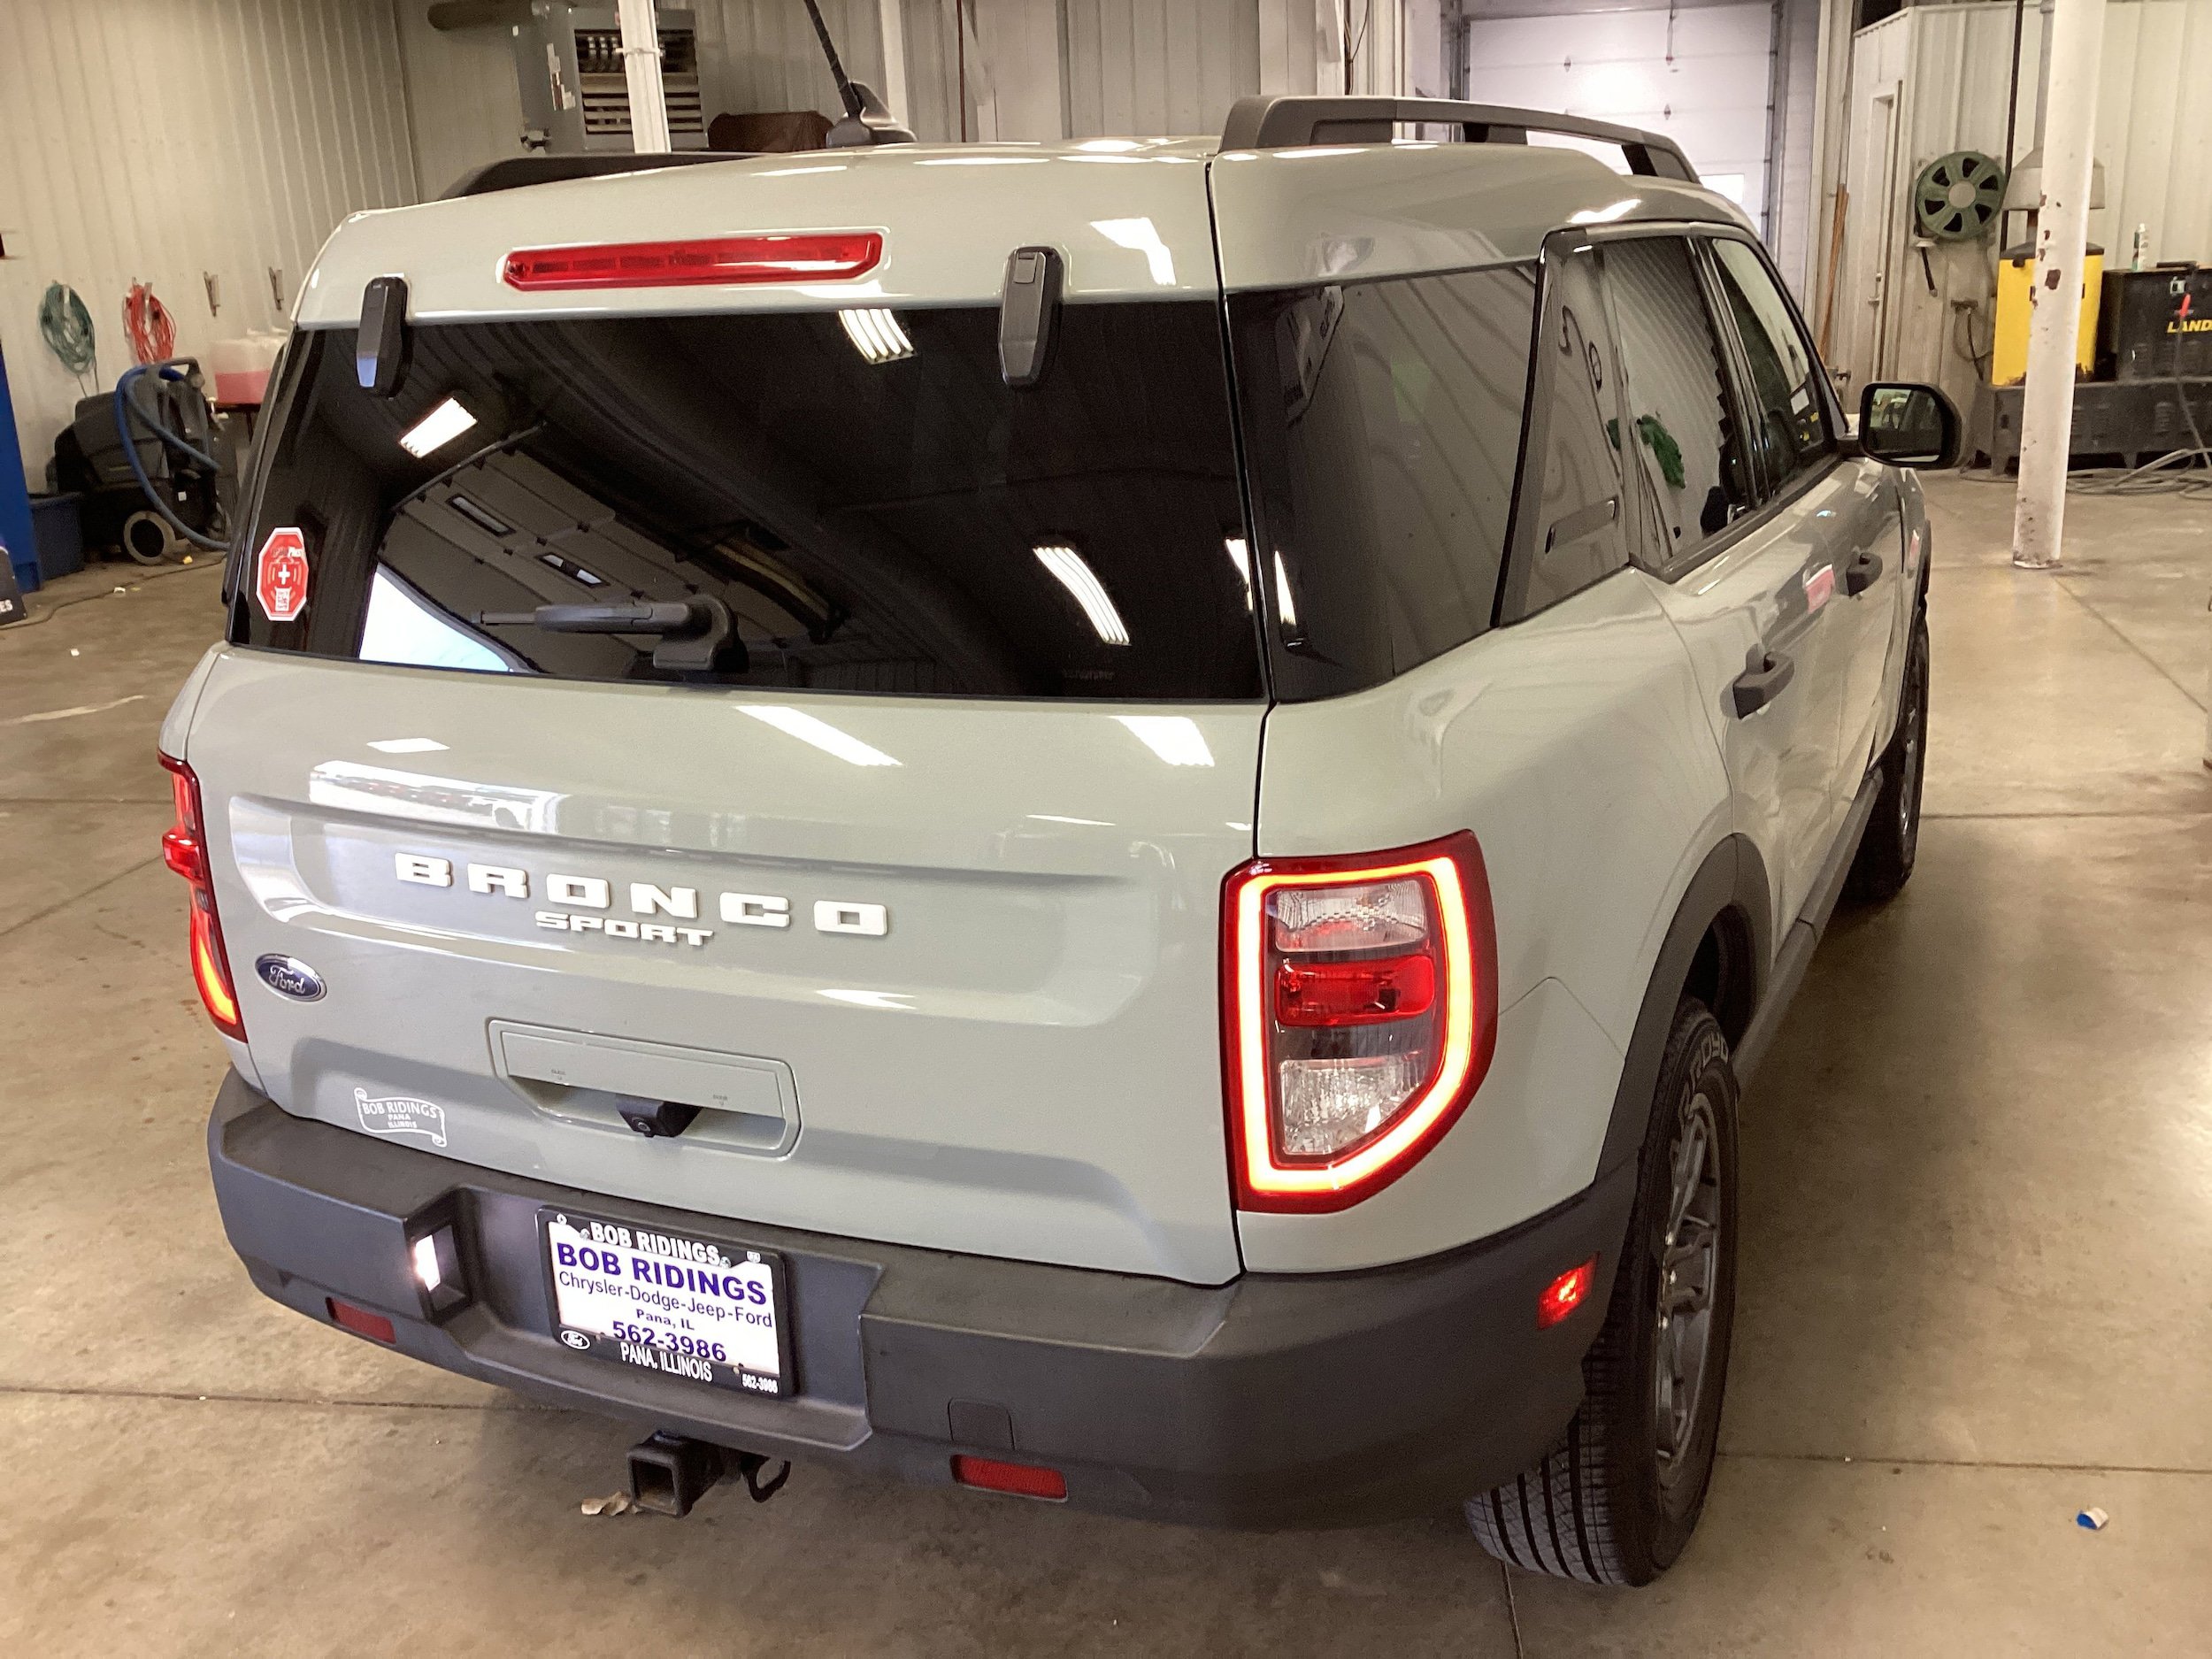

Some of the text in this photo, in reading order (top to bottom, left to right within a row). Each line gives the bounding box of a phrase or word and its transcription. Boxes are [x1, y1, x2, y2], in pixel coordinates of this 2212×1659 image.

[395, 852, 888, 936] BRONCO
[534, 910, 714, 947] SPORT
[269, 964, 306, 995] Ford
[362, 1102, 437, 1118] BOB RIDINGS
[590, 1221, 721, 1266] BOB RIDINGS
[557, 1242, 767, 1305] BOB RIDINGS
[558, 1271, 772, 1328] Chrysler-Dodge-Jeep-Ford
[636, 1309, 695, 1330] Pana, IL
[612, 1320, 726, 1362] 562-3986
[620, 1342, 713, 1382] PANA, ILLINOIS
